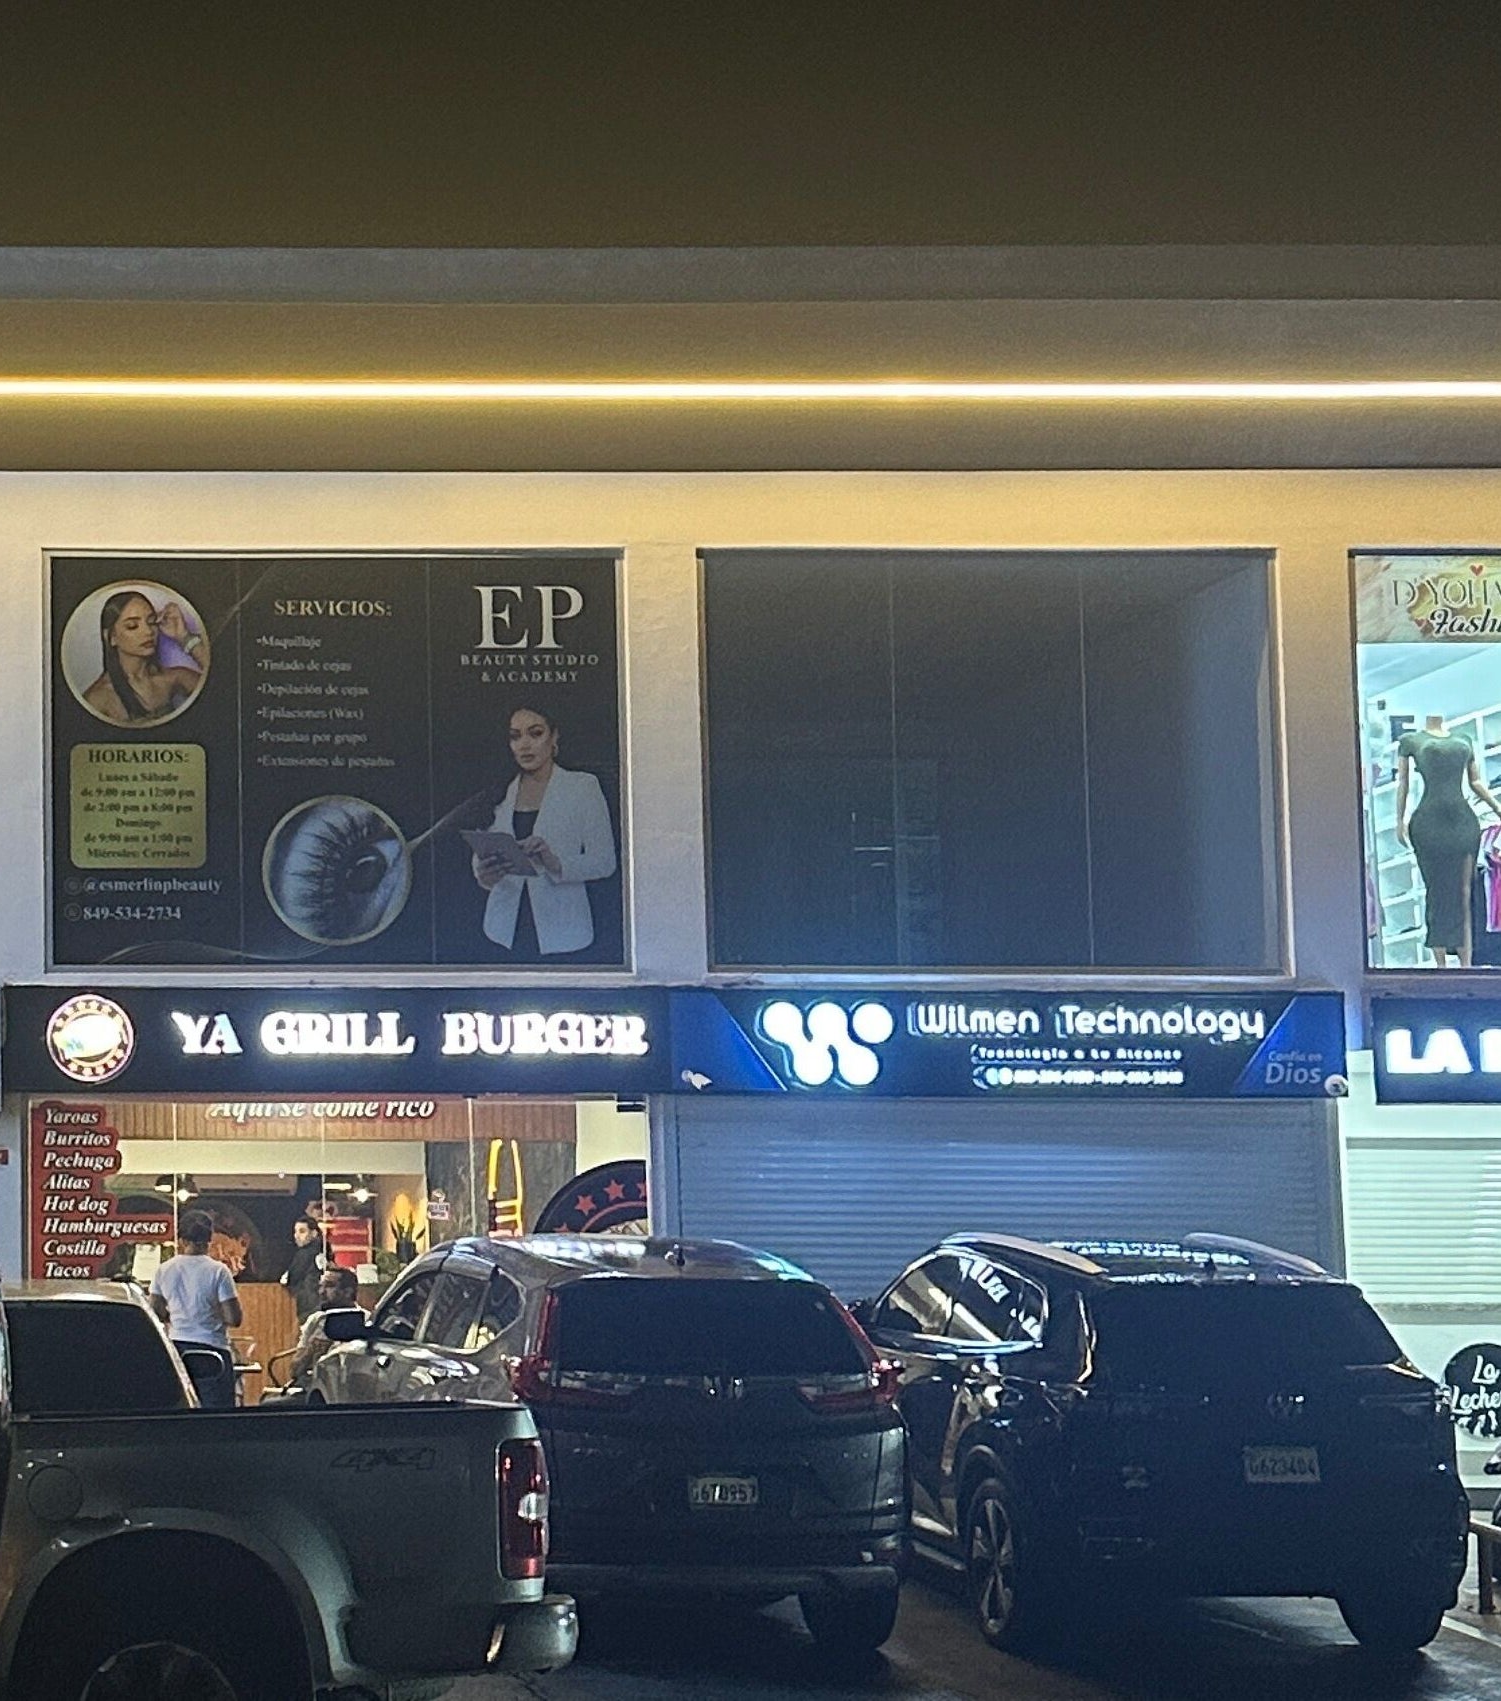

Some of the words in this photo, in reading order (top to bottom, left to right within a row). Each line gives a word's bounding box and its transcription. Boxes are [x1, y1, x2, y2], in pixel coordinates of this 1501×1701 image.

[274, 600, 392, 617] SERVICIOS:
[473, 586, 584, 648] EP
[261, 635, 322, 650] Maquillaje
[262, 659, 305, 671] Tintado
[306, 659, 320, 671] de
[323, 662, 352, 674] cejas
[460, 654, 526, 665] BEAUTY
[532, 654, 599, 665] STUDIO
[496, 671, 579, 682] ACADEMY
[325, 684, 338, 695] de
[312, 733, 331, 746] por
[334, 733, 368, 746] grupo
[88, 749, 189, 764] HORARIOS:
[262, 755, 329, 768] Extensiones
[331, 755, 345, 767] de
[83, 906, 182, 920] 849-534-2734
[915, 1003, 1040, 1035] Wilmen
[1057, 1004, 1264, 1044] Technology
[171, 1011, 243, 1055] YA
[260, 1011, 416, 1055] GRILL
[441, 1011, 650, 1056] BURGER
[1386, 1028, 1474, 1074] LA
[1265, 1062, 1322, 1084] Dios
[45, 1108, 99, 1124] Yaroas
[278, 1102, 306, 1118] se
[312, 1102, 379, 1118] come
[385, 1100, 436, 1118] rico
[44, 1130, 112, 1147] Burritos
[43, 1152, 115, 1171] Pechuga
[43, 1173, 91, 1190] Alitas
[43, 1196, 75, 1212] Hot
[78, 1195, 109, 1215] dog
[43, 1217, 168, 1238] Hamburguesas
[43, 1239, 107, 1256] Costilla
[45, 1262, 90, 1278] Tacos
[1472, 1355, 1501, 1385] La
